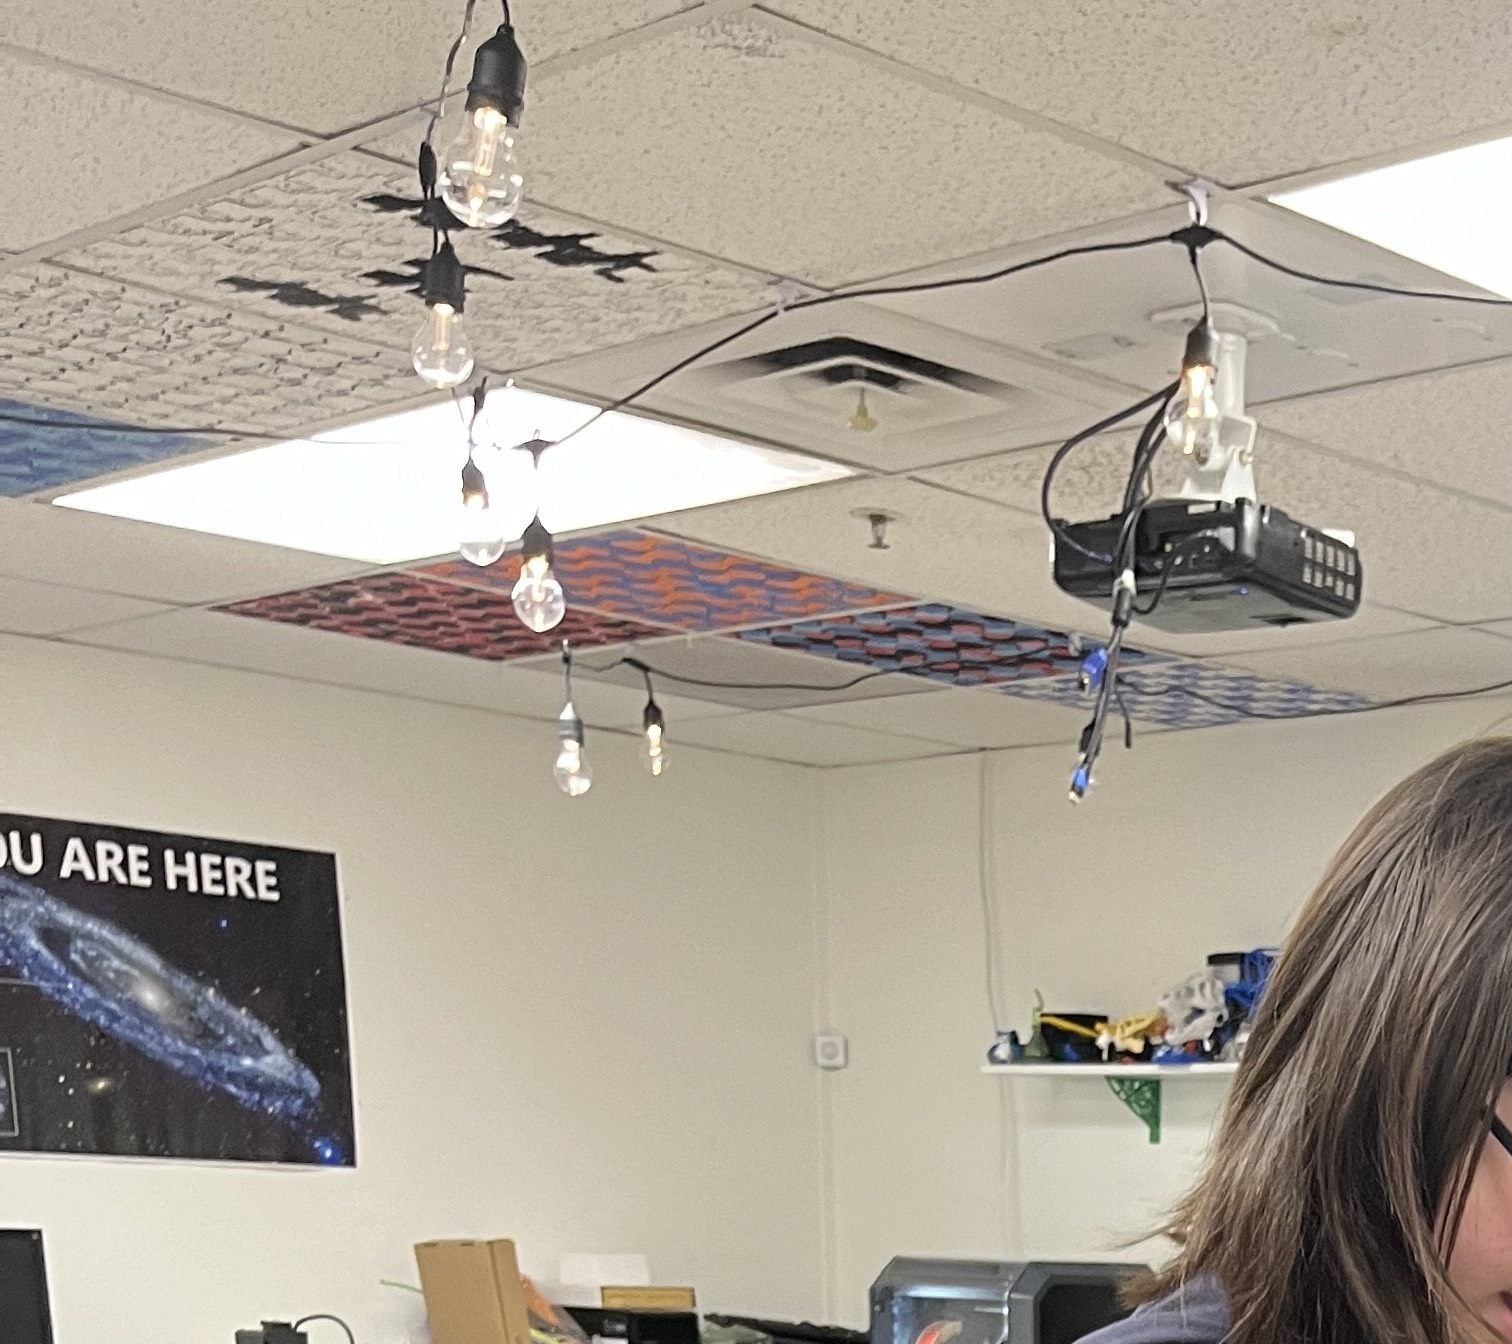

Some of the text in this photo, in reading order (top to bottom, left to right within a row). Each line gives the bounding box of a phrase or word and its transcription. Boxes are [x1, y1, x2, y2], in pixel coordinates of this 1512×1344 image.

[0, 830, 280, 901] U ARE HERE
